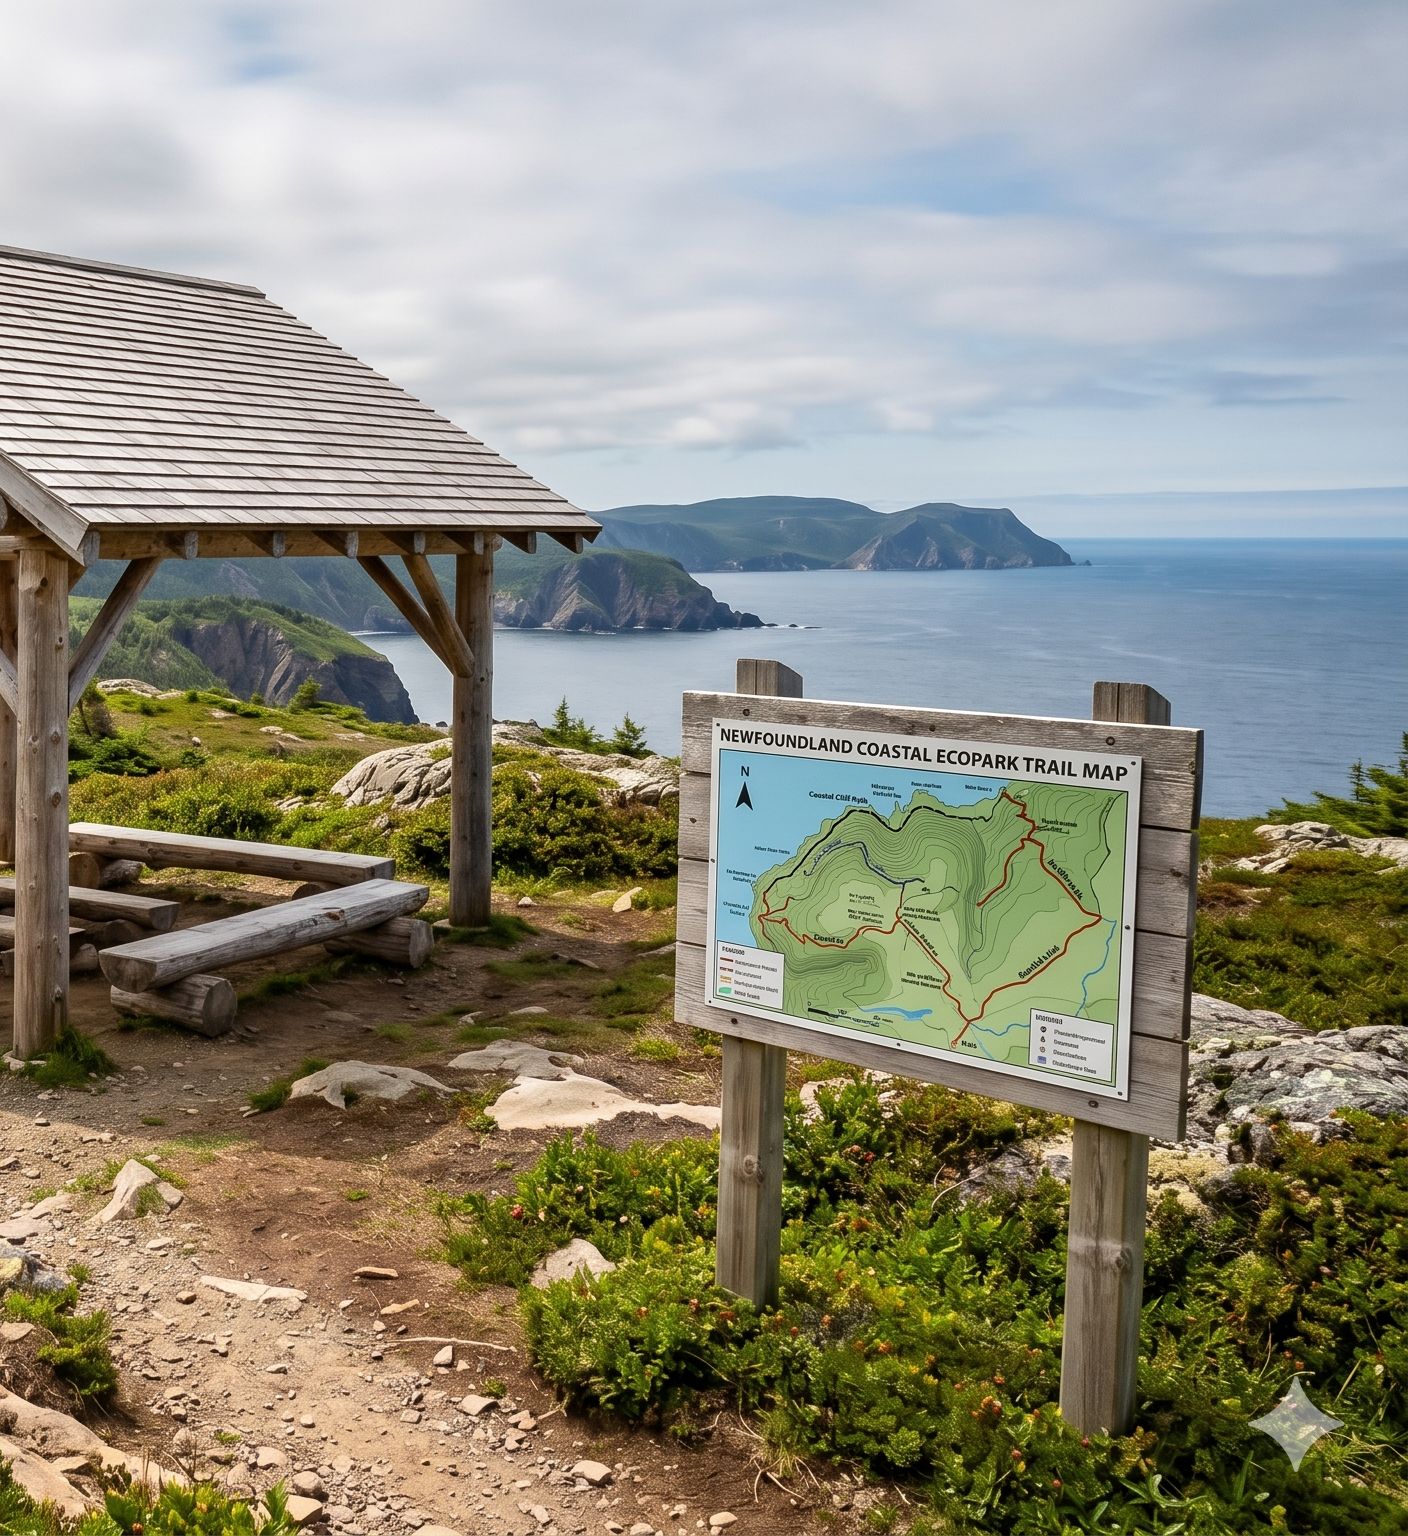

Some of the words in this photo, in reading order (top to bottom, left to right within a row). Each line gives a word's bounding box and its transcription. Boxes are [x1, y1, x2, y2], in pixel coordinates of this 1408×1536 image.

[720, 728, 853, 753] NEWFOUNDLAND
[856, 741, 932, 762] COASTAL
[936, 749, 1020, 772] ECOPARK
[1023, 757, 1078, 777] TRAIL
[1082, 763, 1128, 781] MAP
[741, 766, 750, 777] N
